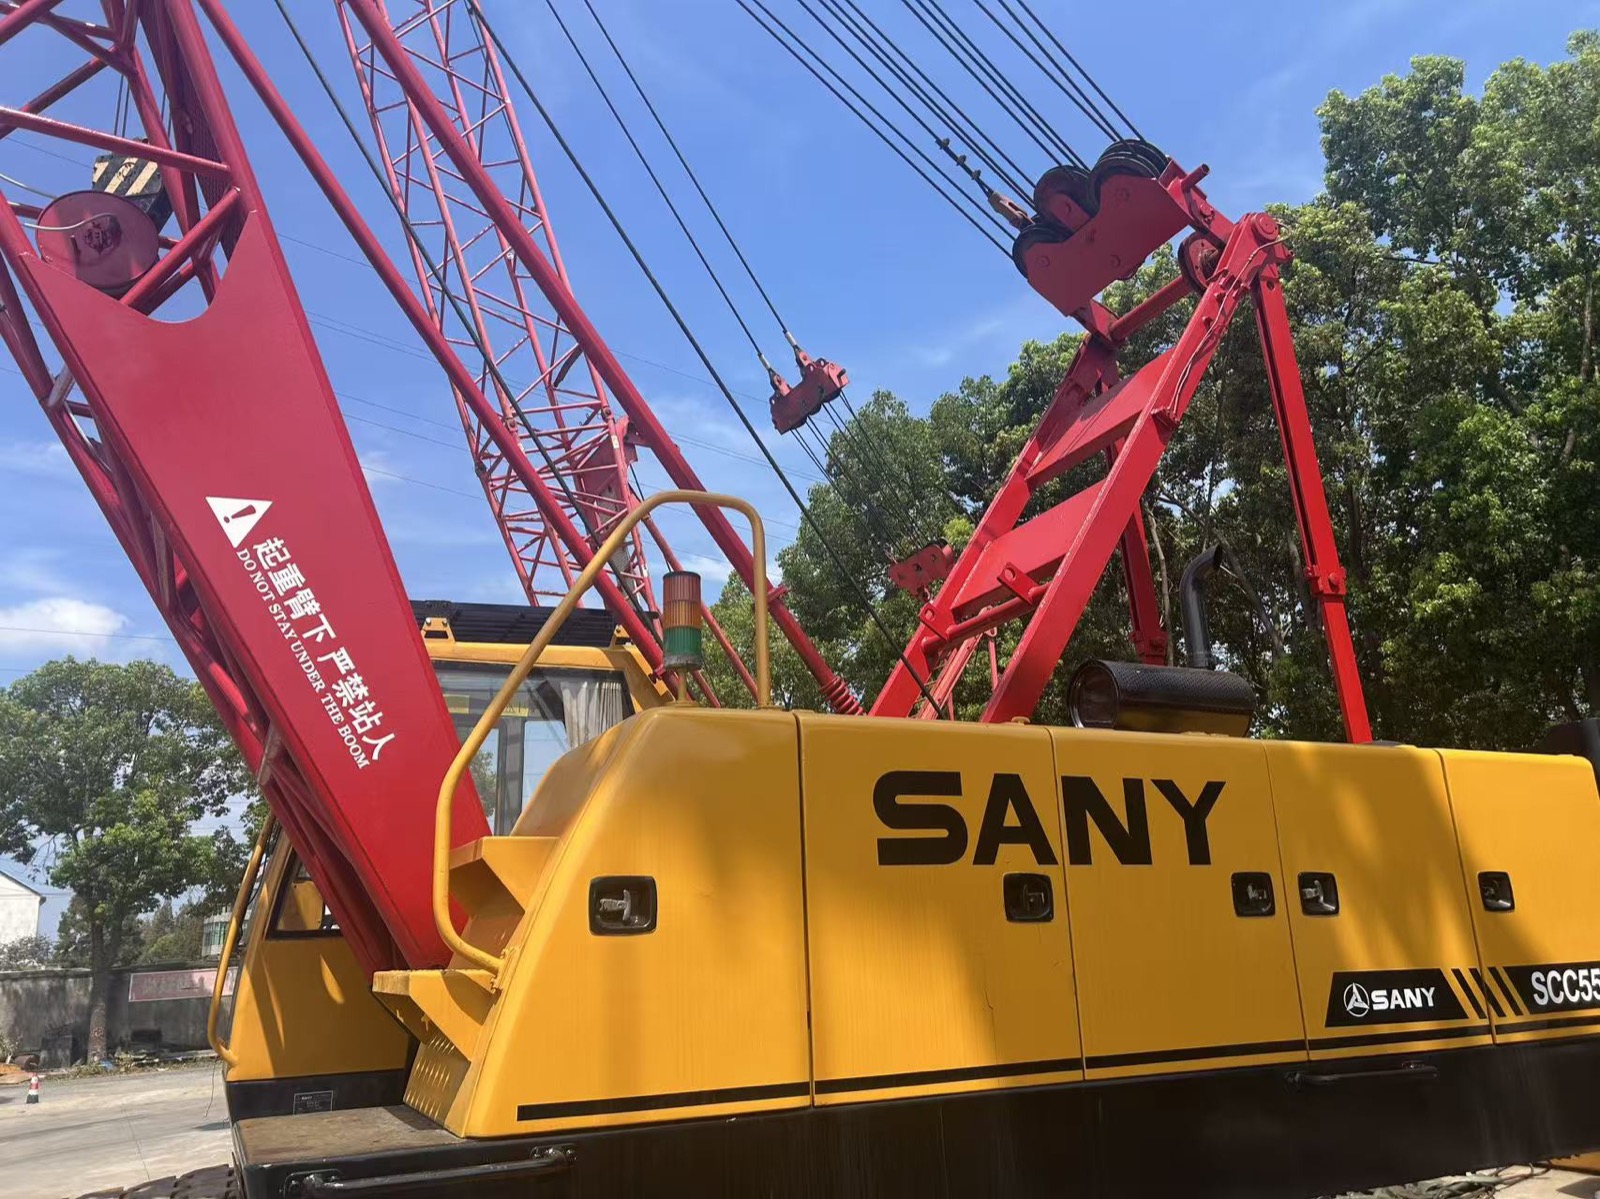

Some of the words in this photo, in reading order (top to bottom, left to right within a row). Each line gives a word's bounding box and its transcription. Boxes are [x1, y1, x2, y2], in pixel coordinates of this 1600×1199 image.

[236, 547, 257, 571] DO
[249, 570, 276, 602] NOT
[268, 603, 298, 640] STAY
[290, 640, 326, 693] UNDER
[321, 692, 345, 725] THE
[337, 724, 370, 769] BOOM
[252, 537, 337, 643] 起重臂下
[316, 646, 395, 760] 严禁站人
[873, 770, 1227, 866] SANY
[1370, 986, 1436, 1011] SANY
[1530, 967, 1600, 1005] SCC55
